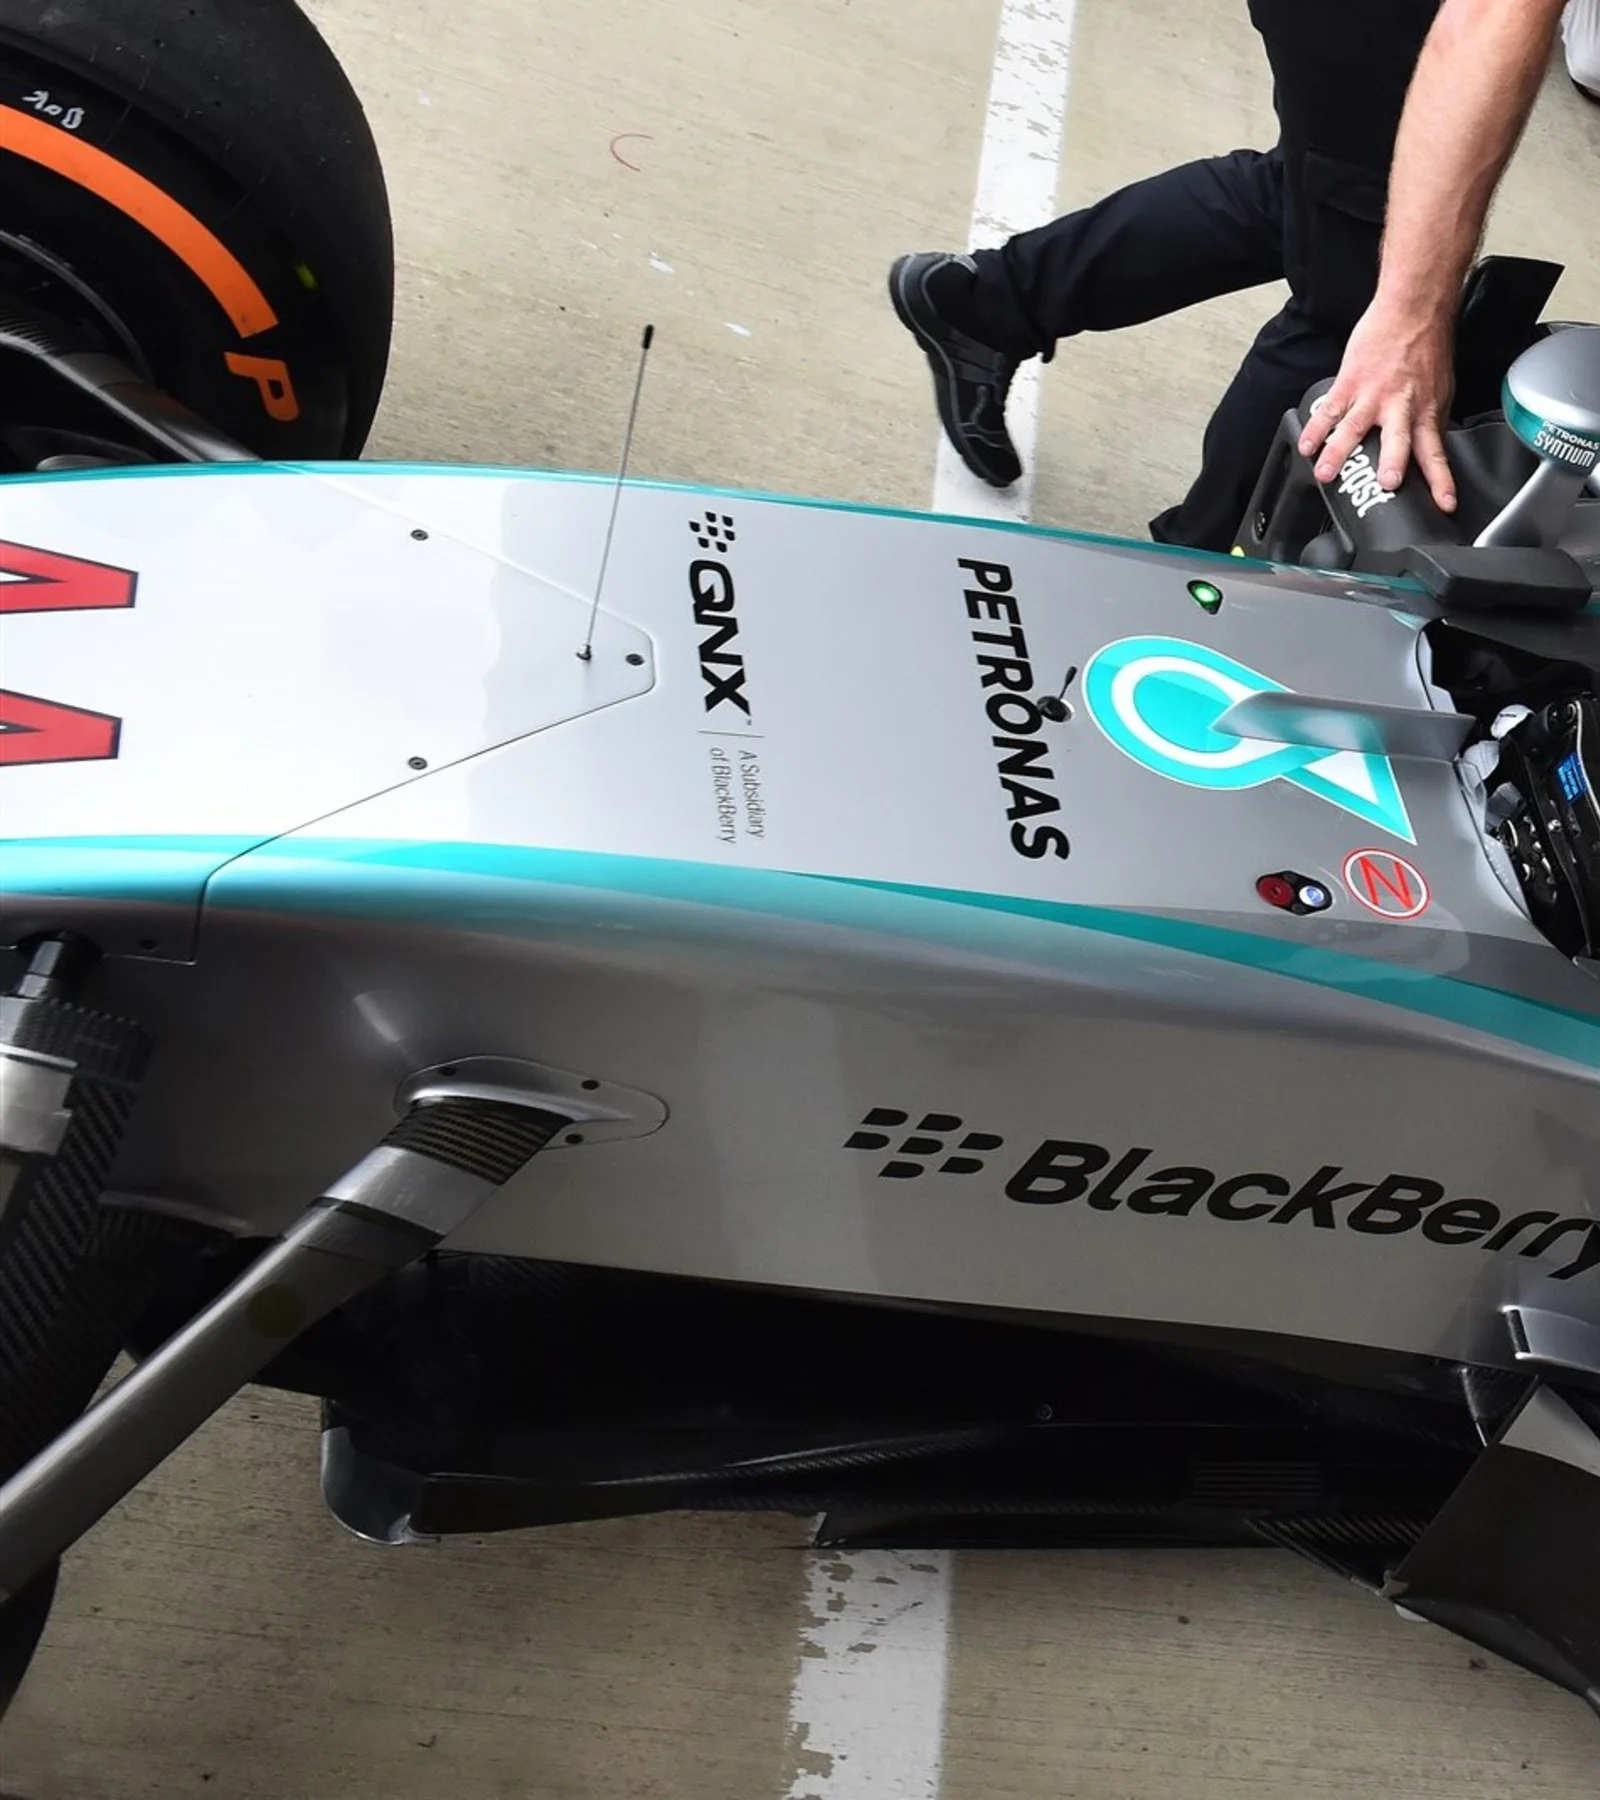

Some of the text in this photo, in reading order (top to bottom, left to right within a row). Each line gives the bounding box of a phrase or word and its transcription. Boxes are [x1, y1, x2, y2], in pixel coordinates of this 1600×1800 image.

[224, 352, 299, 422] P
[1533, 430, 1596, 468] SYNTIUM
[1542, 420, 1600, 451] PETRONAS
[688, 559, 752, 716] QNX
[957, 557, 1070, 860] PETRONAS
[709, 747, 738, 845] of BlackBerry
[738, 750, 768, 838] A Subsidiary
